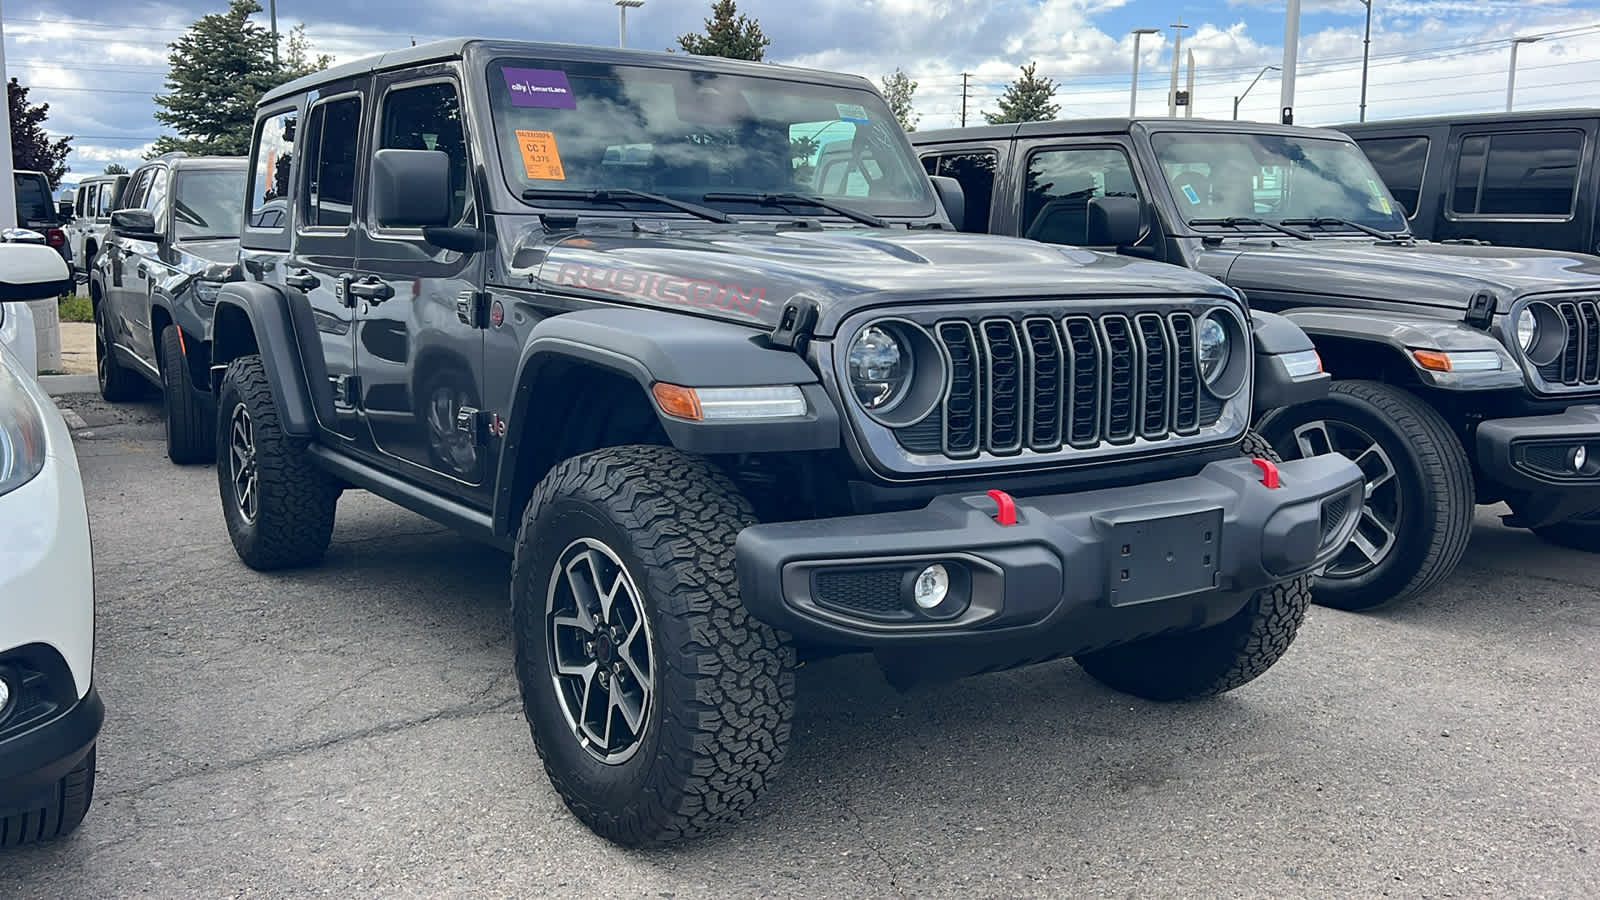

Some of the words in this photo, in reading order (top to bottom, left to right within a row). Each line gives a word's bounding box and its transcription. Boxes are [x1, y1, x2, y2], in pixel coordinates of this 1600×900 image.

[526, 143, 539, 152] CC
[540, 144, 547, 153] 7
[554, 262, 766, 315] RUBICON
